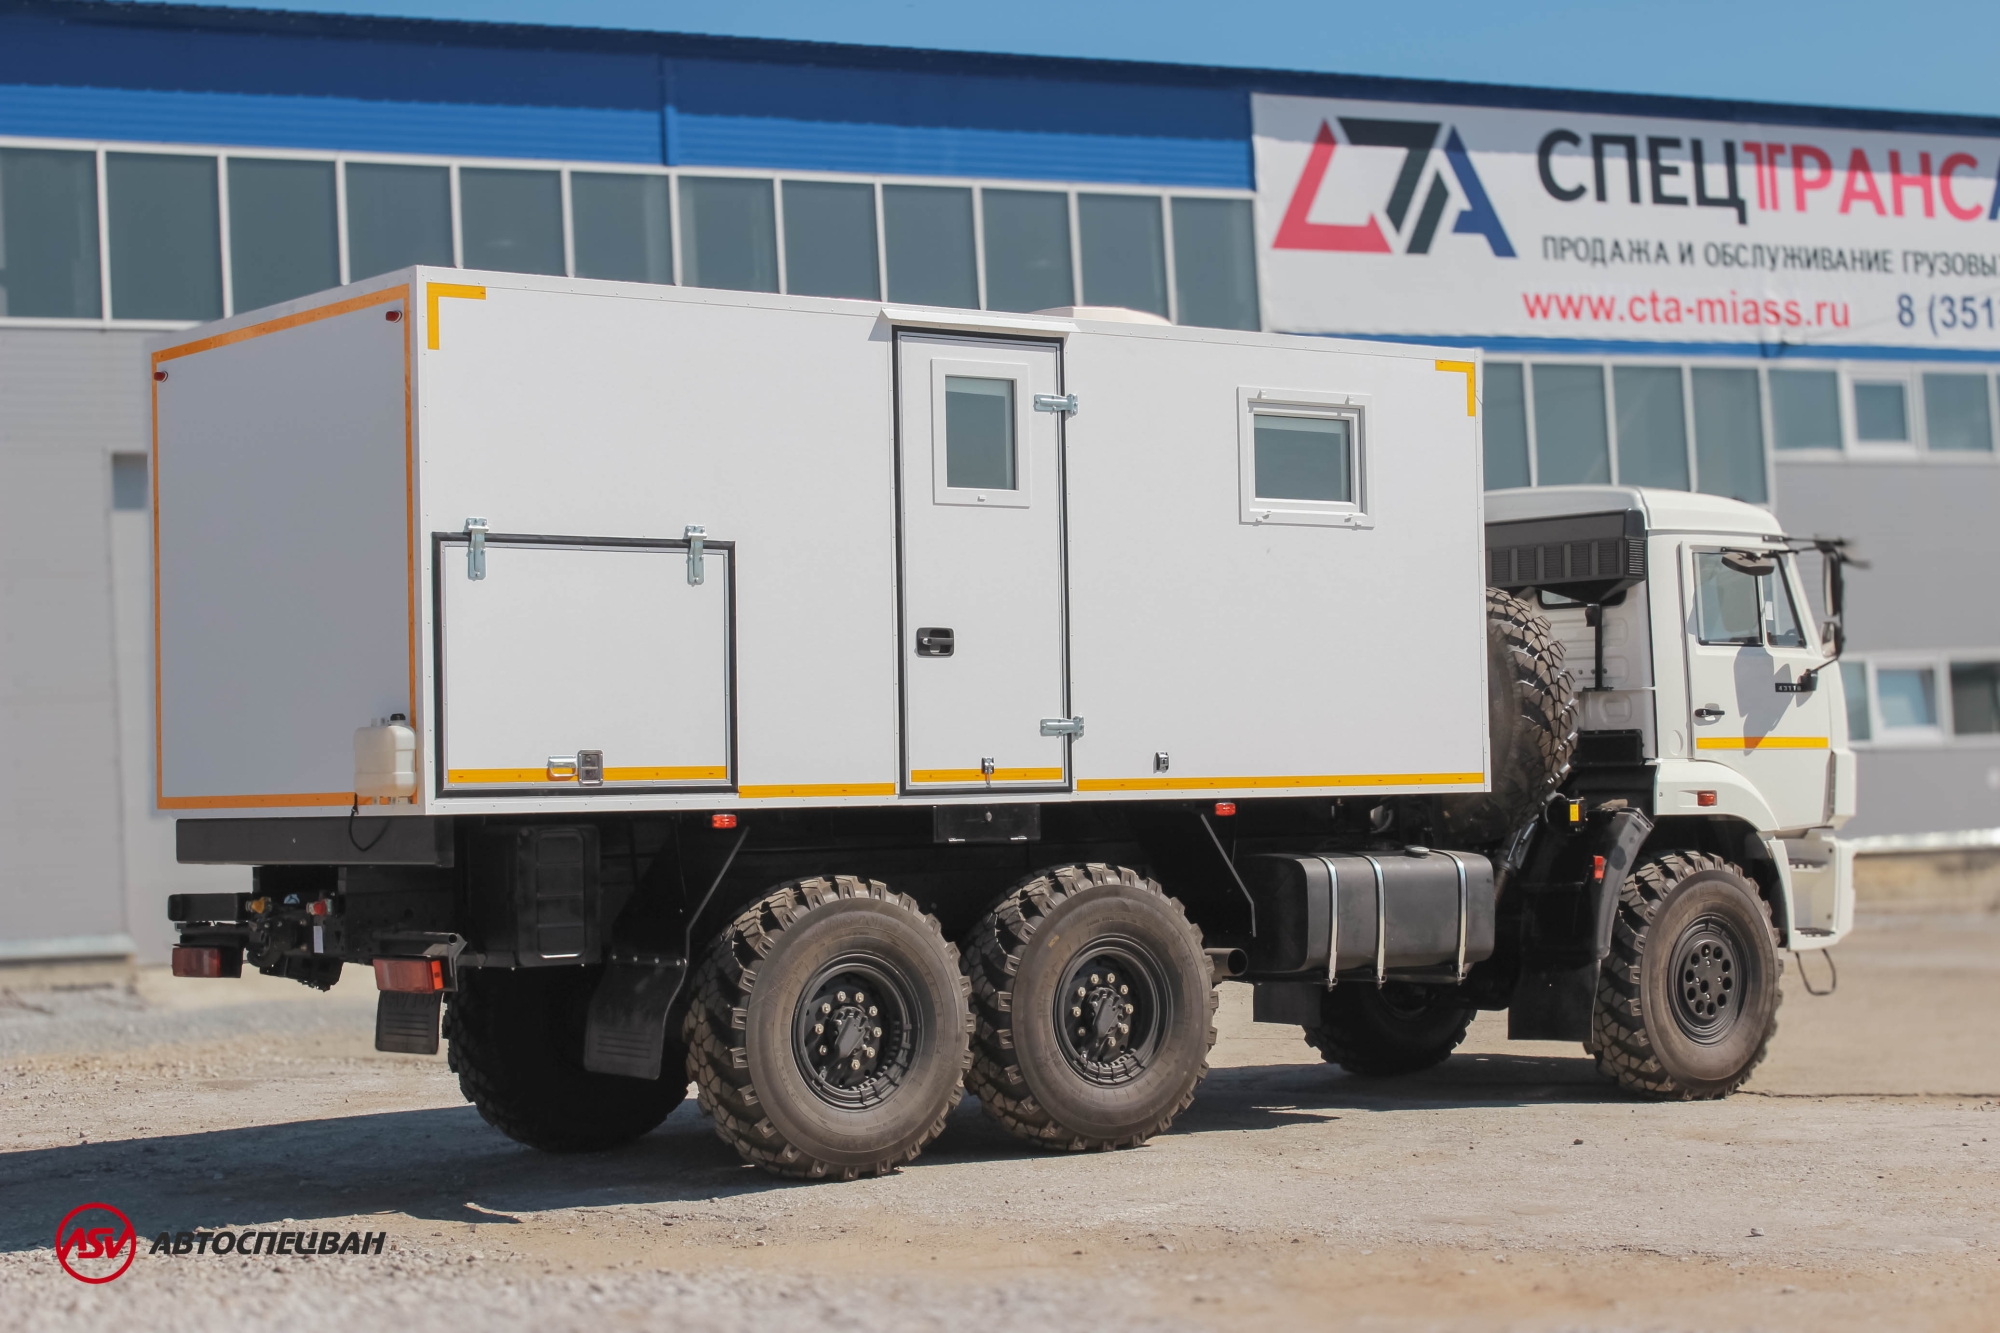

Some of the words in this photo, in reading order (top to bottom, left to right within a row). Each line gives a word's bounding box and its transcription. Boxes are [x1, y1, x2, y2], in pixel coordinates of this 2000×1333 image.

[1542, 236, 1670, 266] ПРОДАЖА
[1680, 242, 1696, 266] И
[1703, 243, 1894, 274] ОБСЛУЖИВАНИЕ
[1902, 249, 2000, 278] ГРУЗОВЫ
[1523, 290, 1849, 329] www.cta-miass.ru
[1897, 293, 1915, 328] 8
[1928, 294, 2000, 337] (351
